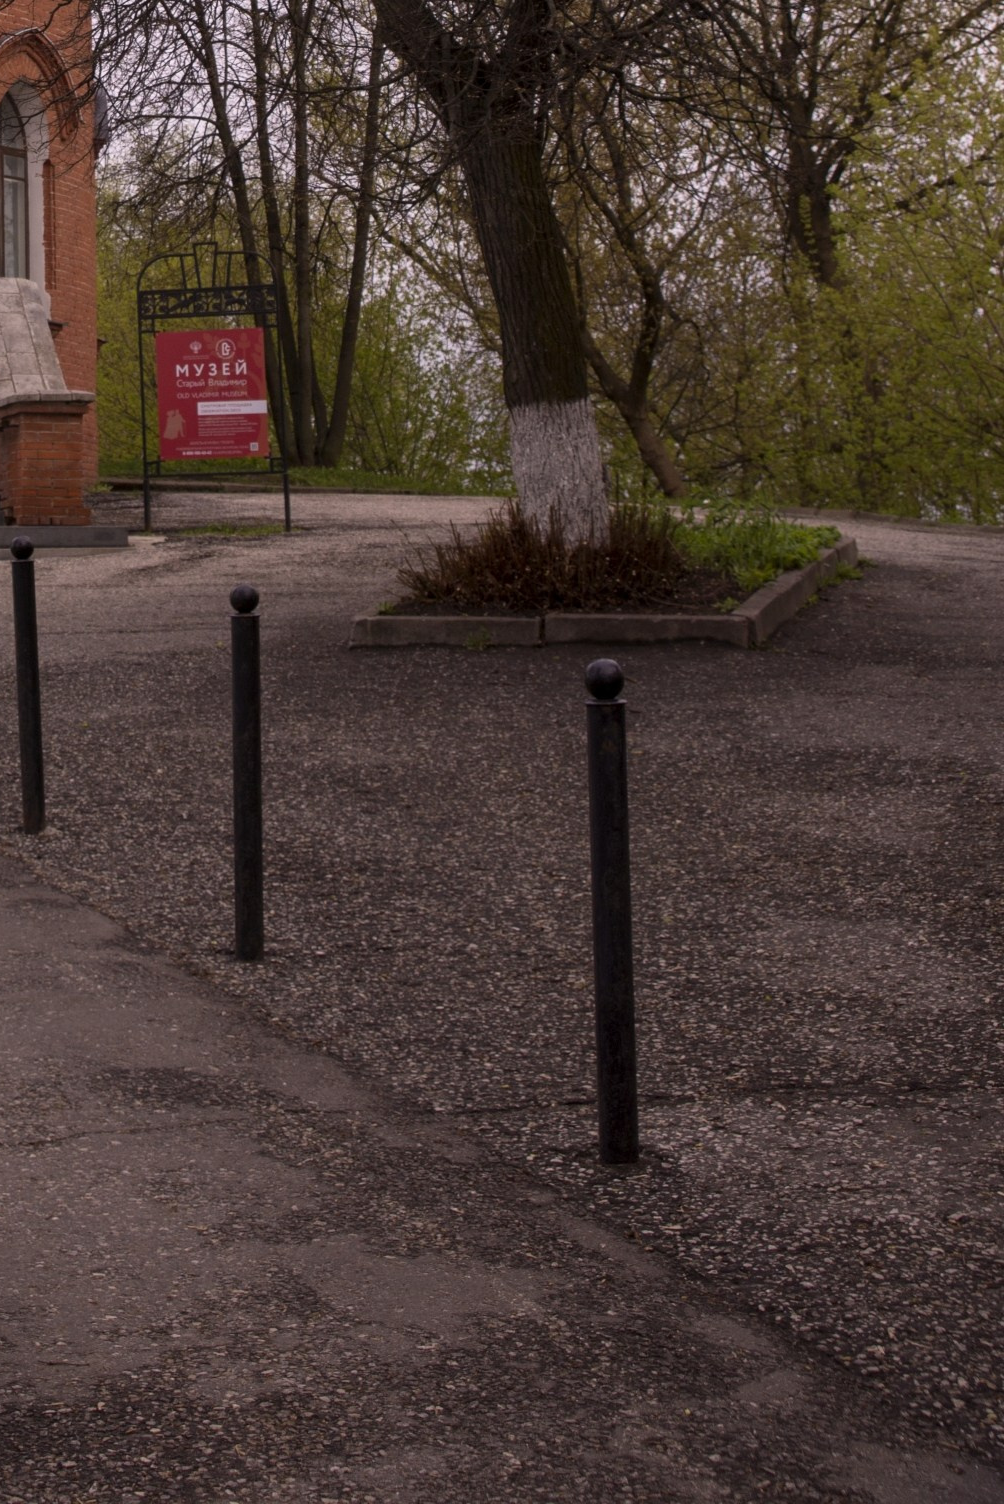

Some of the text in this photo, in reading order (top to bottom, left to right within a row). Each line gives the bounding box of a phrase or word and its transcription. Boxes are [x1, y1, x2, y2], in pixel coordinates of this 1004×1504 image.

[176, 360, 247, 377] МУЗЕЙ
[176, 378, 247, 388] Старый Владимир
[192, 391, 220, 399] VLADIMIR
[222, 390, 248, 398] MUSEUM
